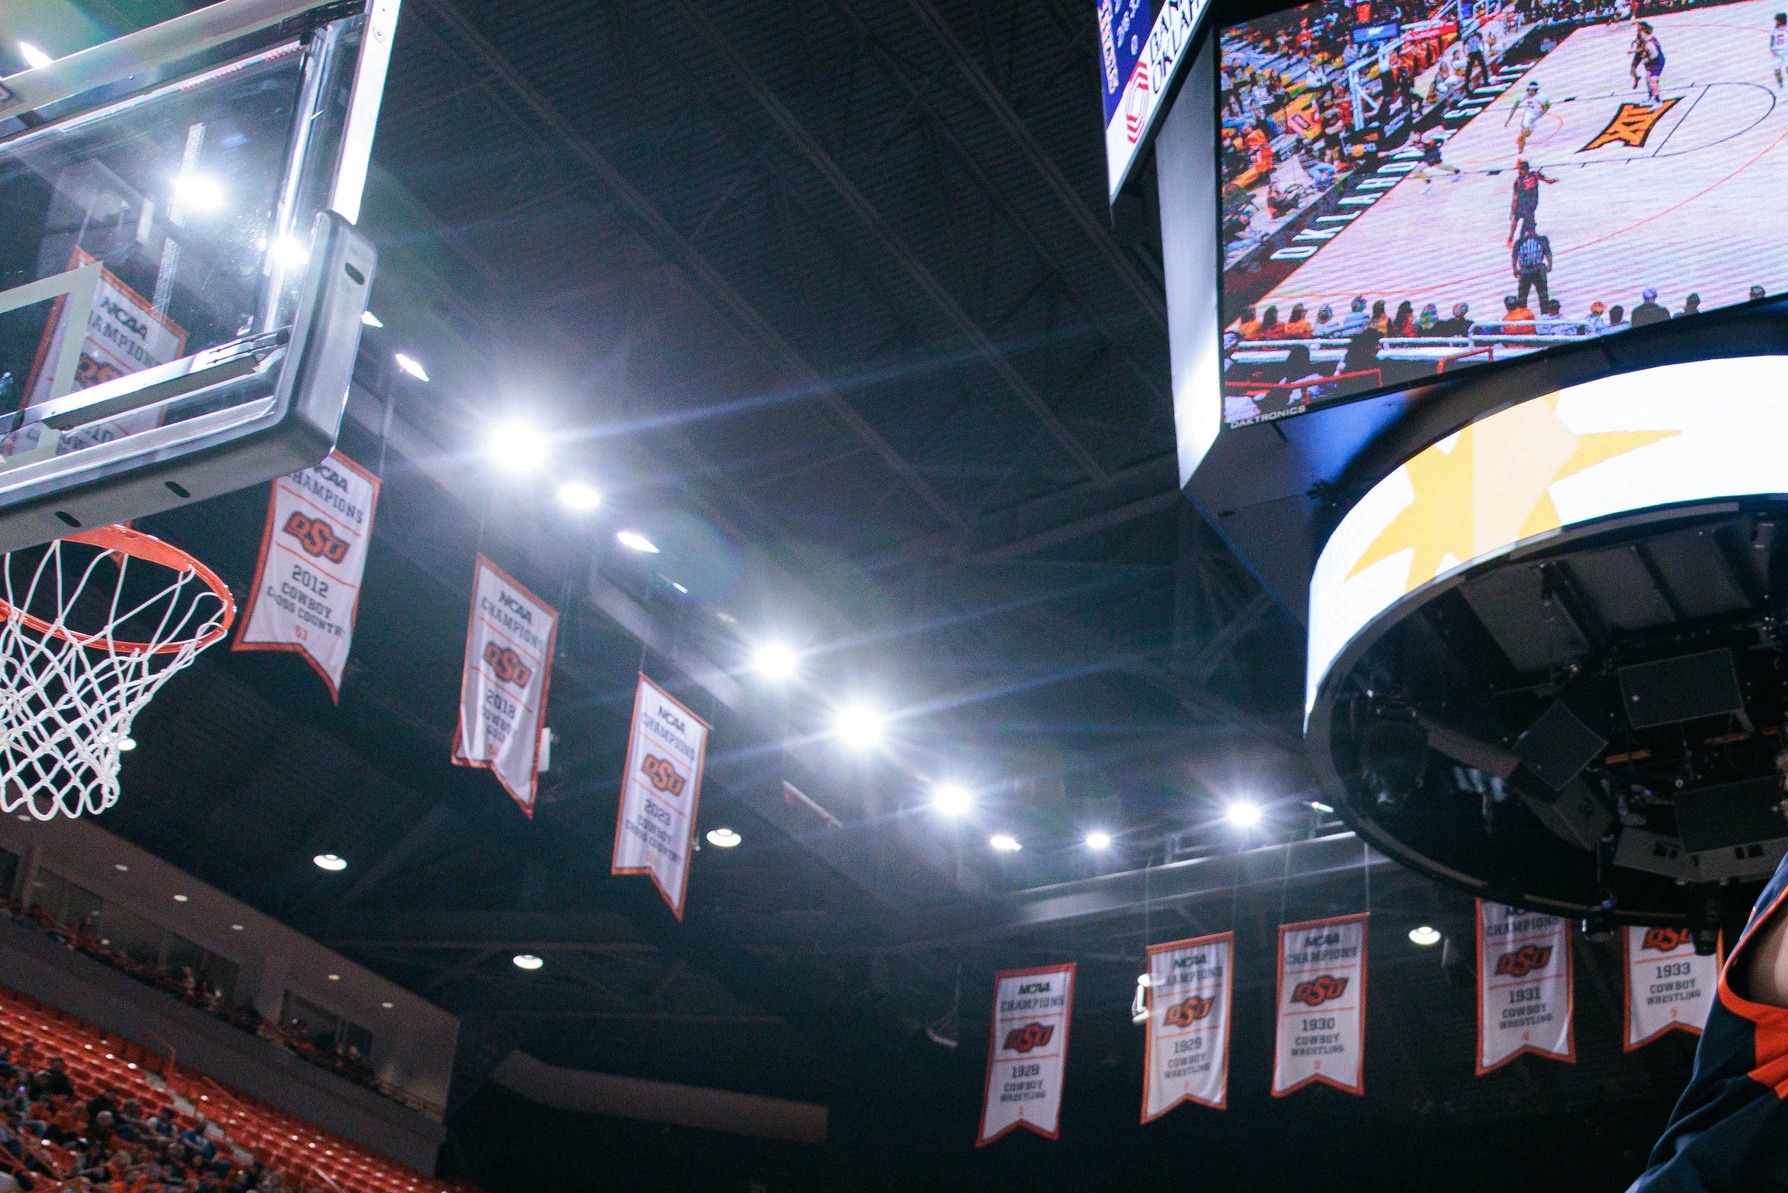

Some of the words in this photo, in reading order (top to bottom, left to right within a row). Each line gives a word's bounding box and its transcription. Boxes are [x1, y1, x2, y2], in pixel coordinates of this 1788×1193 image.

[1230, 404, 1307, 429] DAKTRONICS
[291, 564, 328, 598] 2012
[281, 581, 332, 620] COWBOY
[1655, 962, 1691, 979] 1933
[1649, 978, 1696, 994] COWBOY
